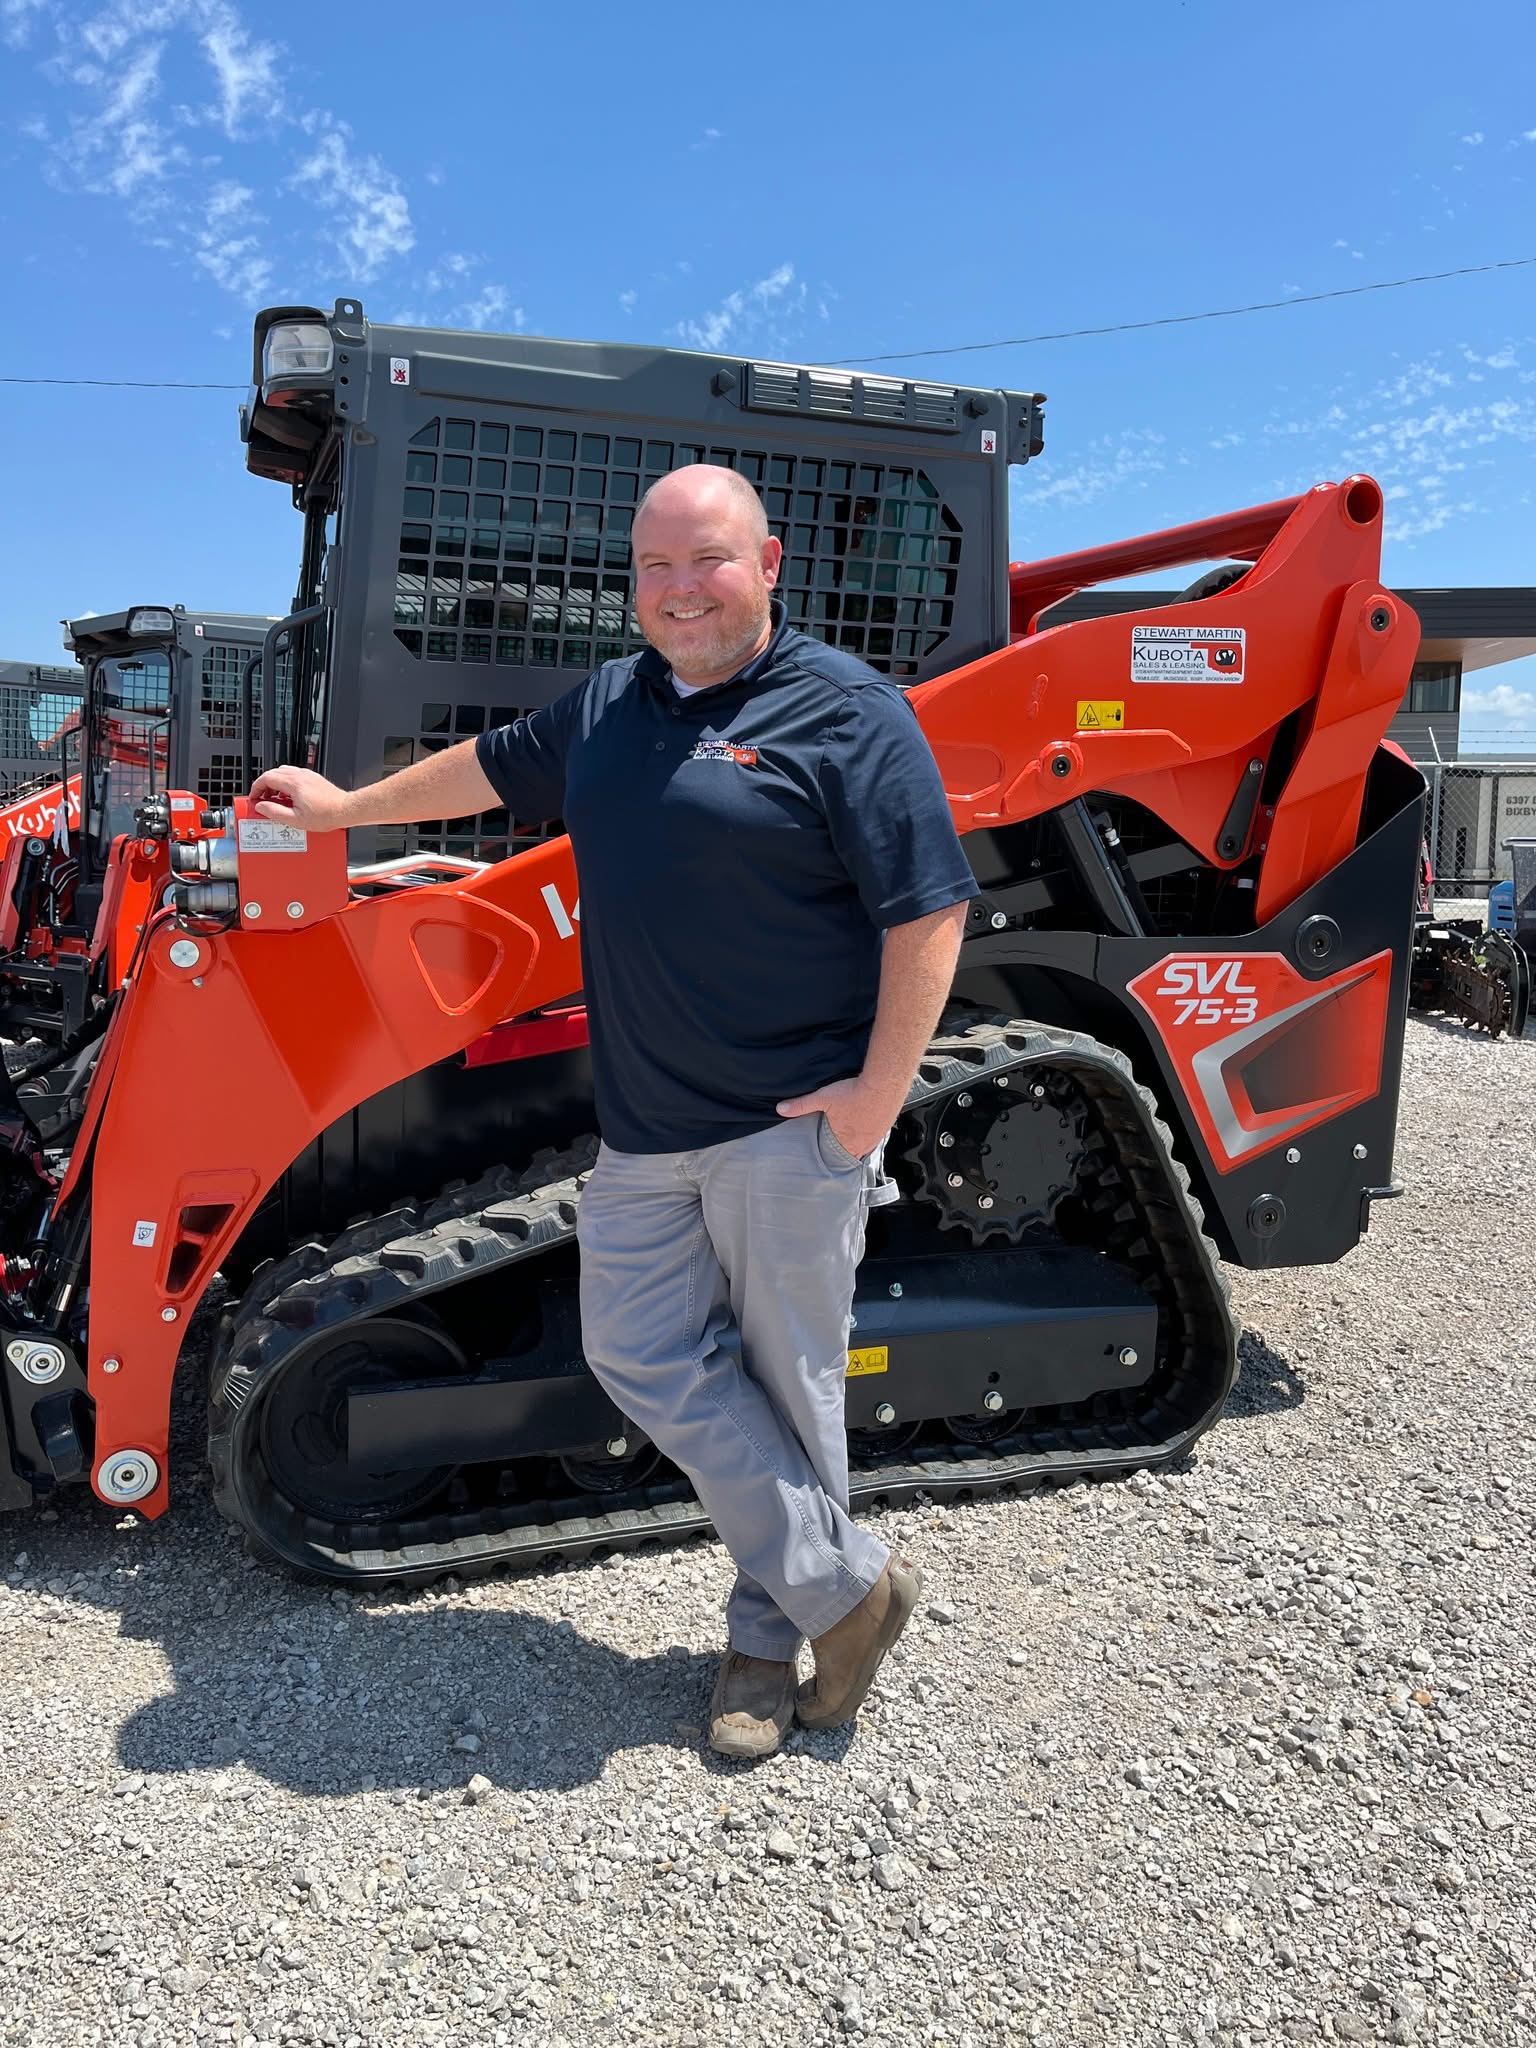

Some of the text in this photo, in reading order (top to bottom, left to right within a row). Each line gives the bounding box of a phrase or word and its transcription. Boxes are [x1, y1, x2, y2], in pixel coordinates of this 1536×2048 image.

[1134, 627, 1242, 639] STEWART MARTIN
[1133, 646, 1204, 661] KUBOTA
[1132, 661, 1160, 669] SALES
[695, 747, 735, 757] KUBOTA
[730, 742, 758, 750] MARTIN
[1156, 962, 1256, 995] SVL
[1173, 998, 1258, 1025] 75-3
